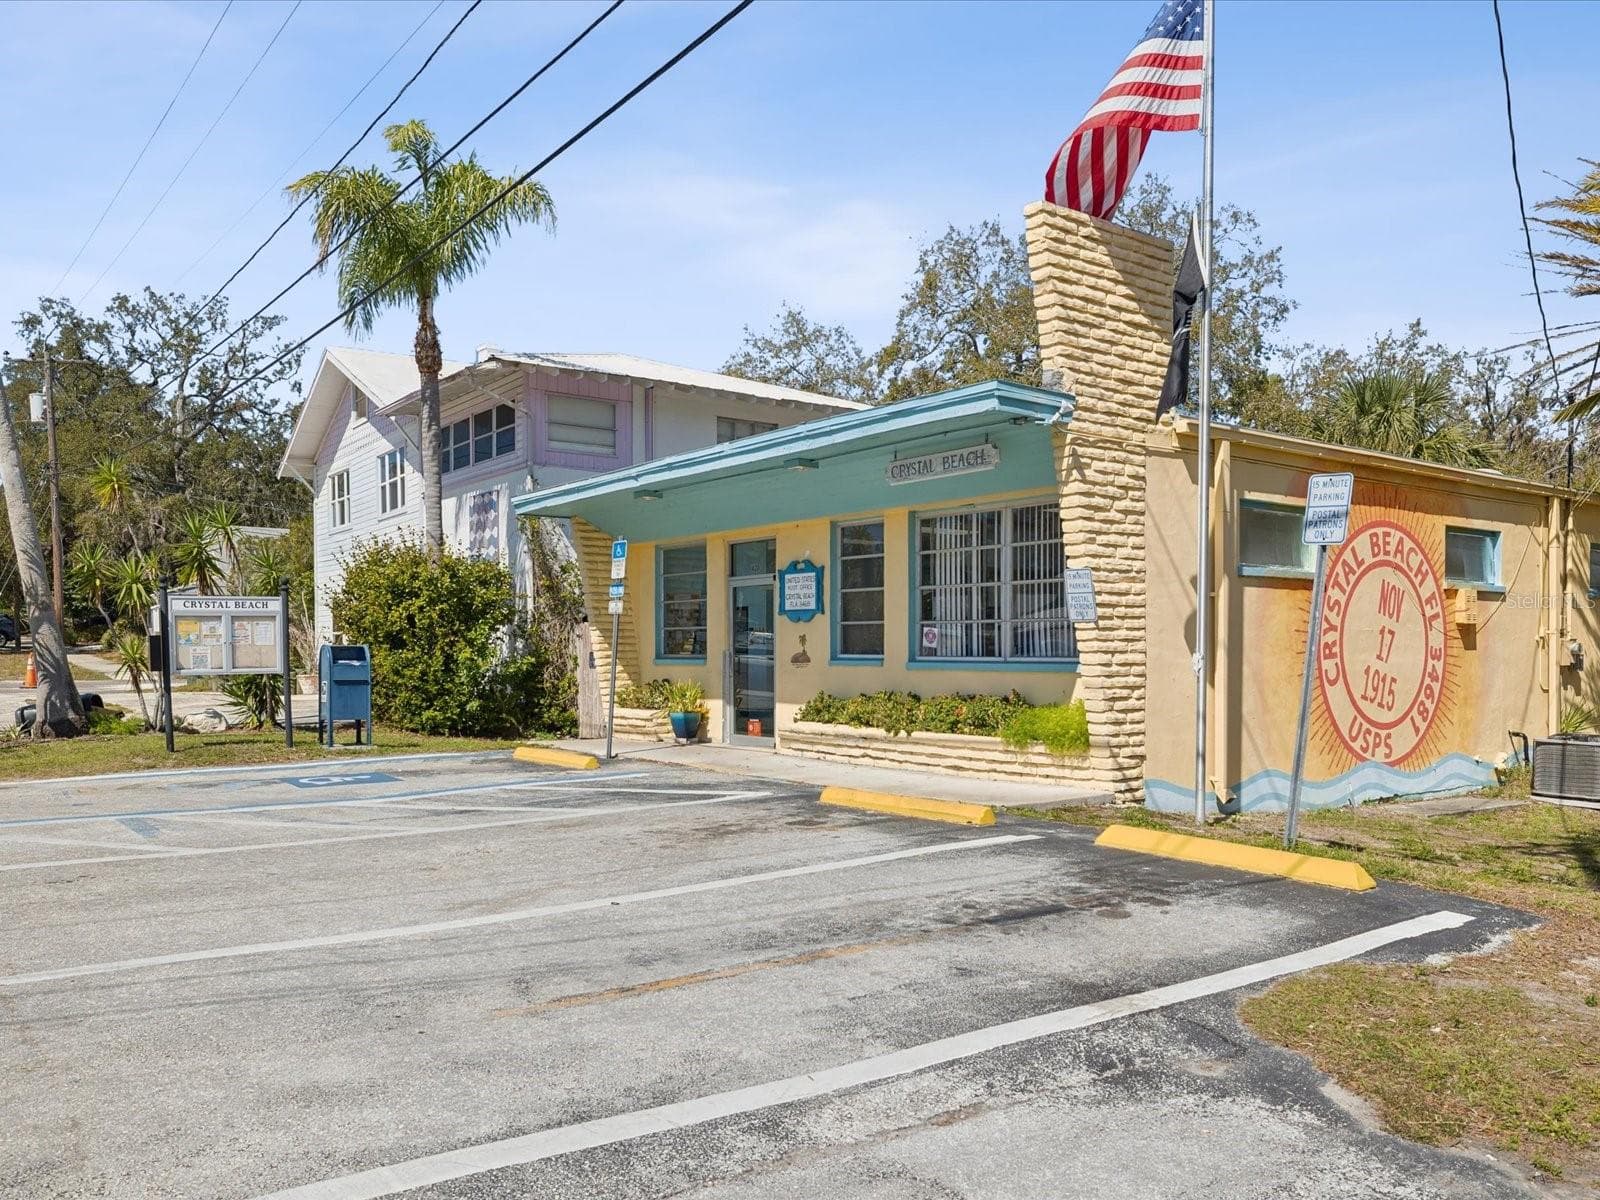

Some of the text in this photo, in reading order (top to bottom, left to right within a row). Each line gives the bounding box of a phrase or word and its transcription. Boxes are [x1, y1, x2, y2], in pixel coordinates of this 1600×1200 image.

[890, 449, 984, 479] CRYSTAL BEACH
[1313, 479, 1348, 489] 15 MINUTE
[1313, 493, 1345, 502] PARKING
[1312, 510, 1341, 520] POSTAL
[1307, 520, 1344, 529] PATRONS
[1314, 530, 1335, 539] ONLY
[1070, 595, 1091, 603] POSTAL
[1378, 578, 1405, 623] NOV
[183, 600, 269, 609] CRYSTAL BEACH
[1075, 610, 1089, 618] ONLY
[1322, 531, 1443, 739] CRYSTAL BEACH FL 34681
[1375, 625, 1396, 664] 17
[1360, 664, 1397, 712] 1915
[1348, 715, 1393, 760] USPS
